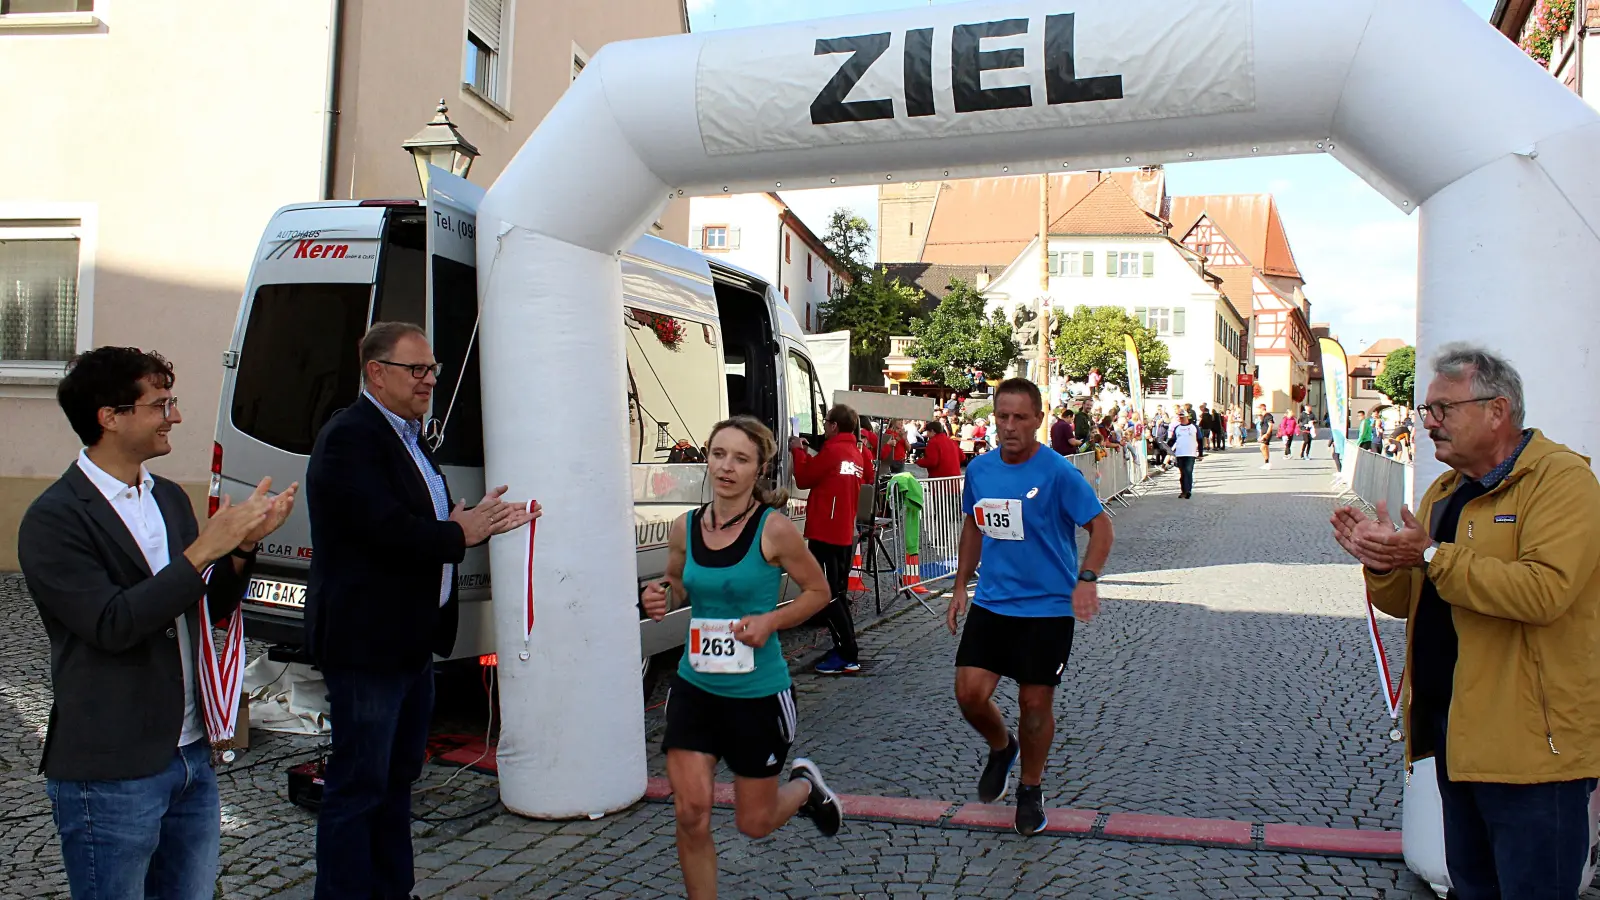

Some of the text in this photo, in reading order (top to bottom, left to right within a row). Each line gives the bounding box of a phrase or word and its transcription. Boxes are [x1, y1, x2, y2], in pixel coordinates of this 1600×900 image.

[809, 12, 1124, 125] ZIEL
[434, 210, 455, 233] Tel.
[293, 239, 349, 259] Kern
[985, 512, 1010, 528] 135
[267, 543, 292, 556] CAR
[248, 580, 274, 599] ROT
[280, 585, 297, 604] AK
[702, 638, 735, 657] 263
